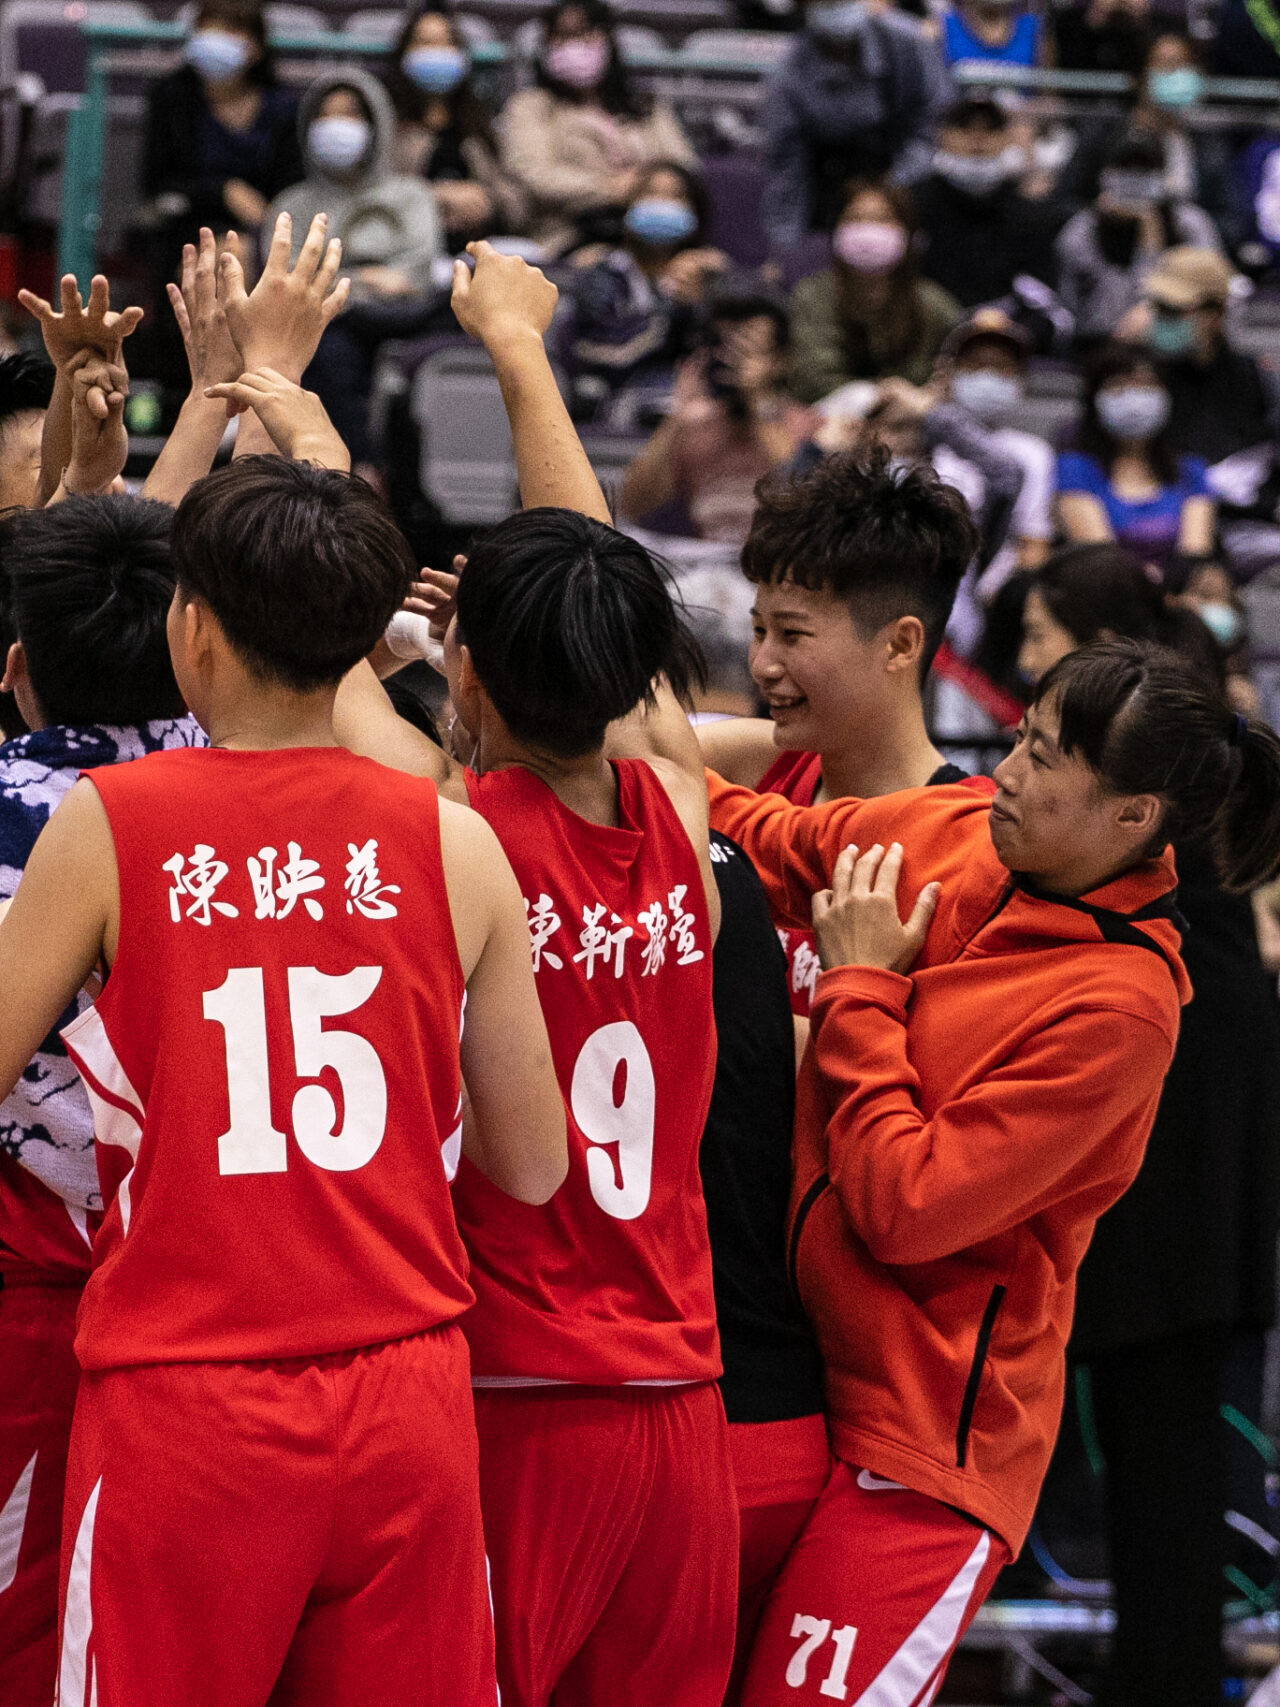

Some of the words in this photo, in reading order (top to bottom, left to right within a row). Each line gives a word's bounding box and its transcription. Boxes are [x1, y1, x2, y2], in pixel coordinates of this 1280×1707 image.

[162, 838, 402, 927] 陳映慈
[202, 966, 388, 1176] 15
[571, 1020, 656, 1221] 9
[785, 1613, 858, 1700] 71
